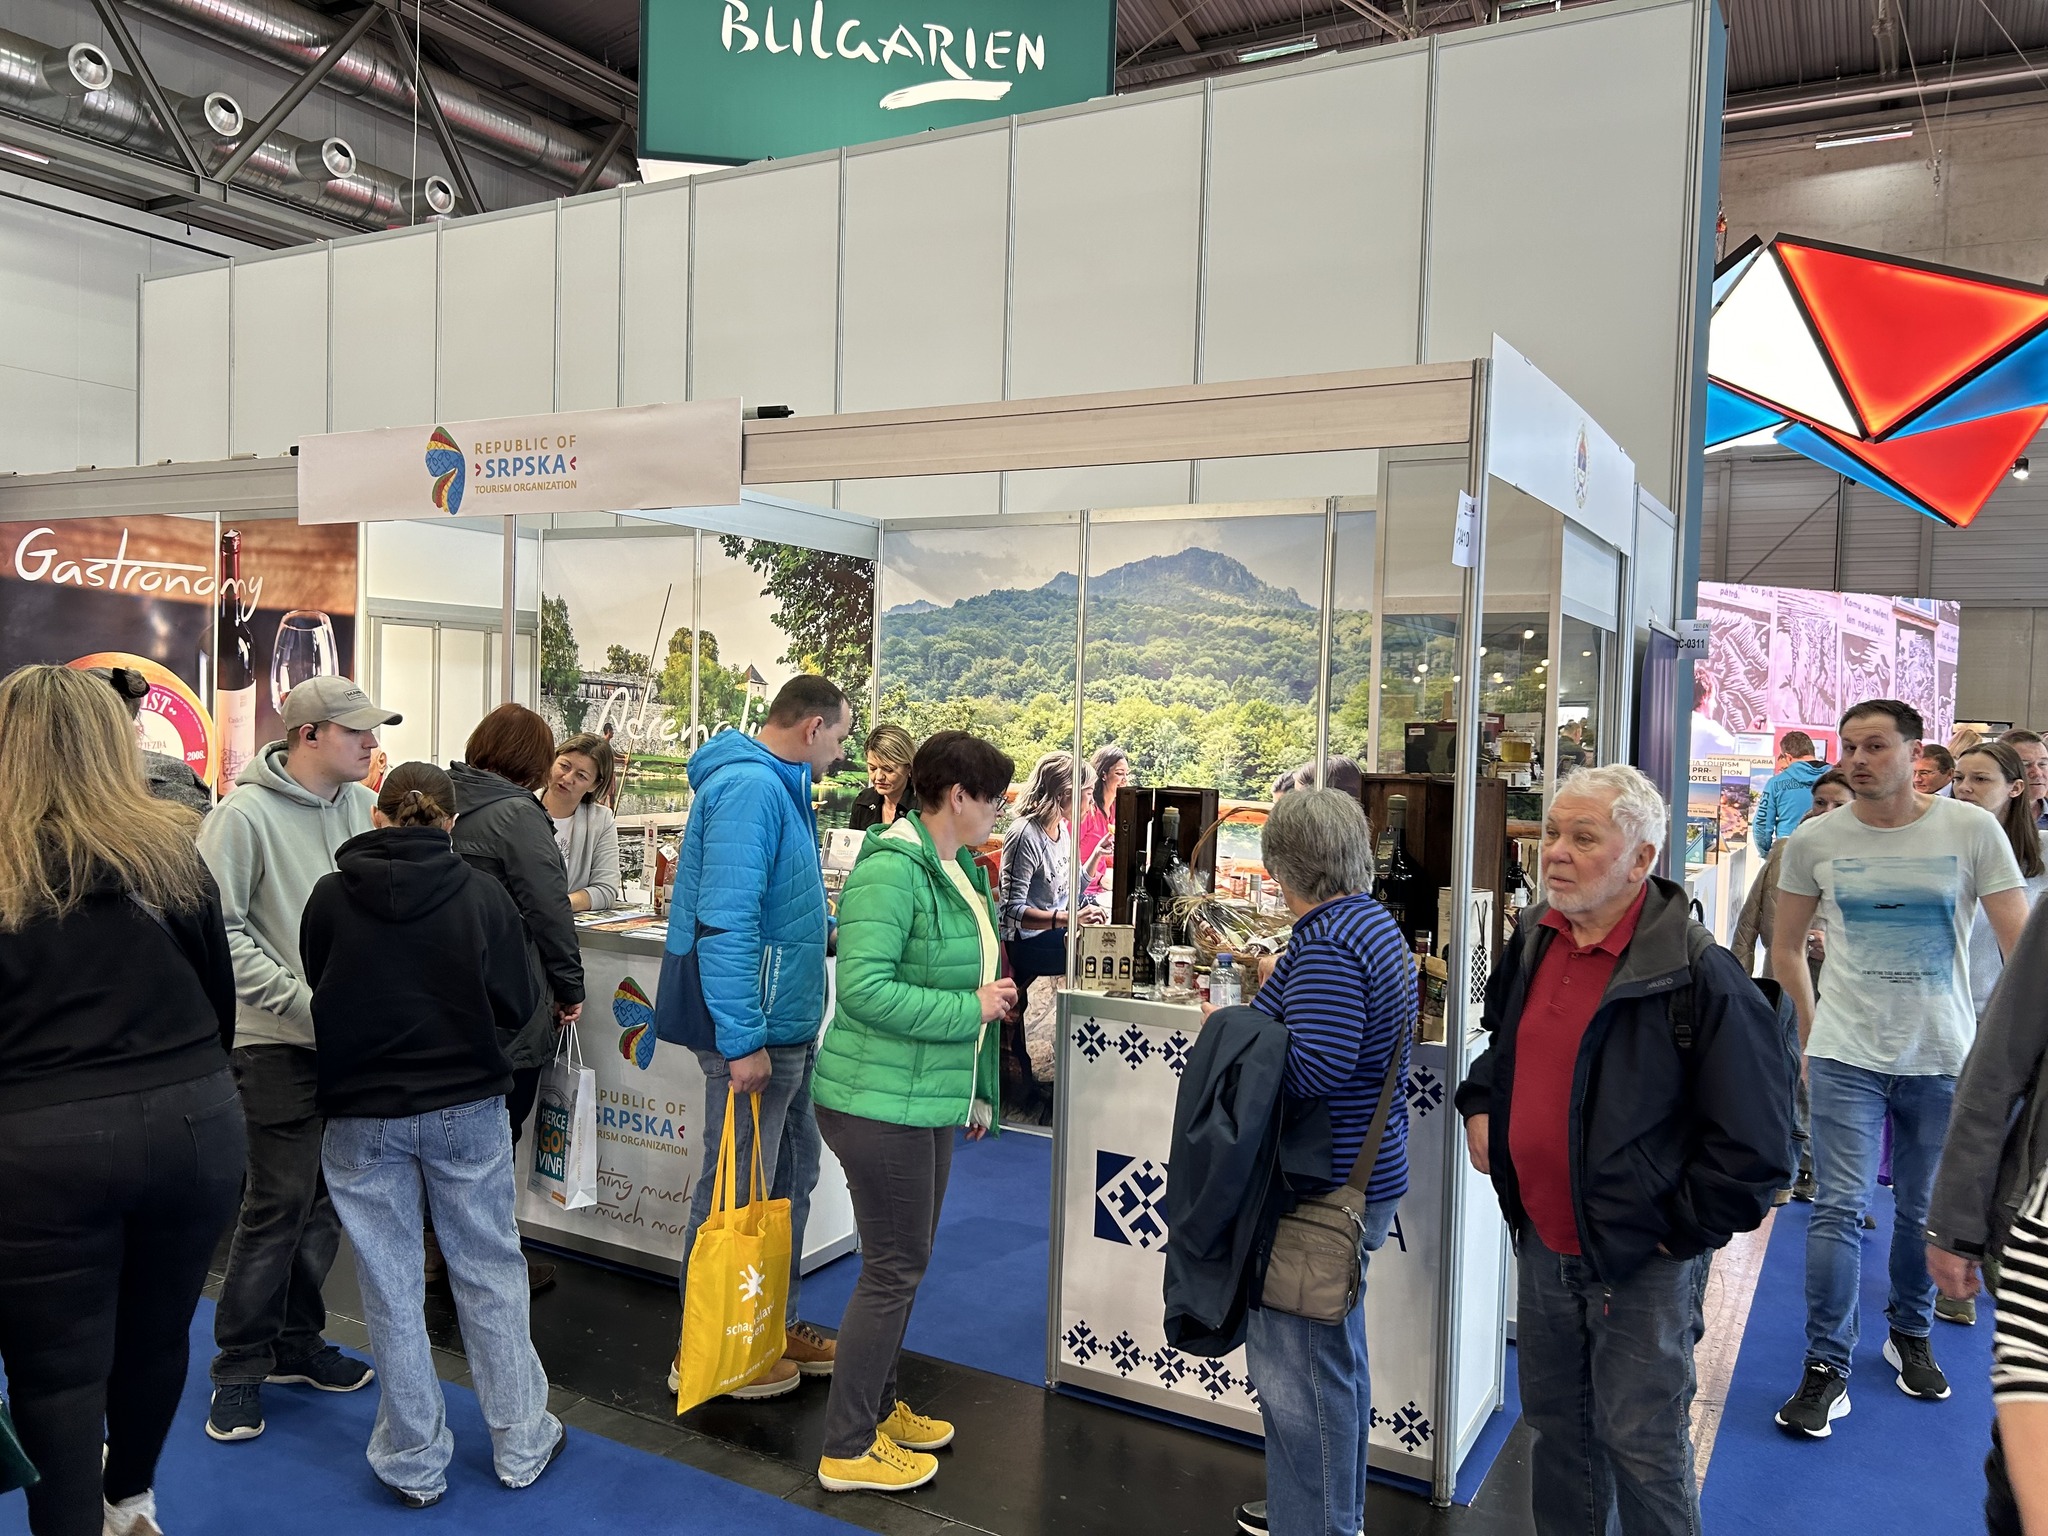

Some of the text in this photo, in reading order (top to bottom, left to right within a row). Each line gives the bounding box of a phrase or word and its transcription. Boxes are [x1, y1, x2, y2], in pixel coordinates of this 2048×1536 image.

[720, 0, 1045, 80] BULGARIEN
[475, 435, 577, 455] REPUBLIC OF
[485, 454, 567, 479] SRPSKA
[475, 480, 577, 494] TOURISM ORGANIZATION
[15, 527, 263, 622] Gastronomy
[594, 676, 764, 742] Adrenali
[186, 750, 205, 761] 2008.
[765, 945, 783, 1014] UNDER ARMOUR
[600, 1089, 686, 1117] PUBLIC OF
[541, 1108, 567, 1130] HERCE
[540, 1124, 565, 1158] GO!
[597, 1129, 688, 1157] RISM ORGANIZATION
[538, 1150, 563, 1177] VINA
[640, 1173, 692, 1204] much
[594, 1196, 644, 1227] much
[651, 1220, 686, 1237] mor
